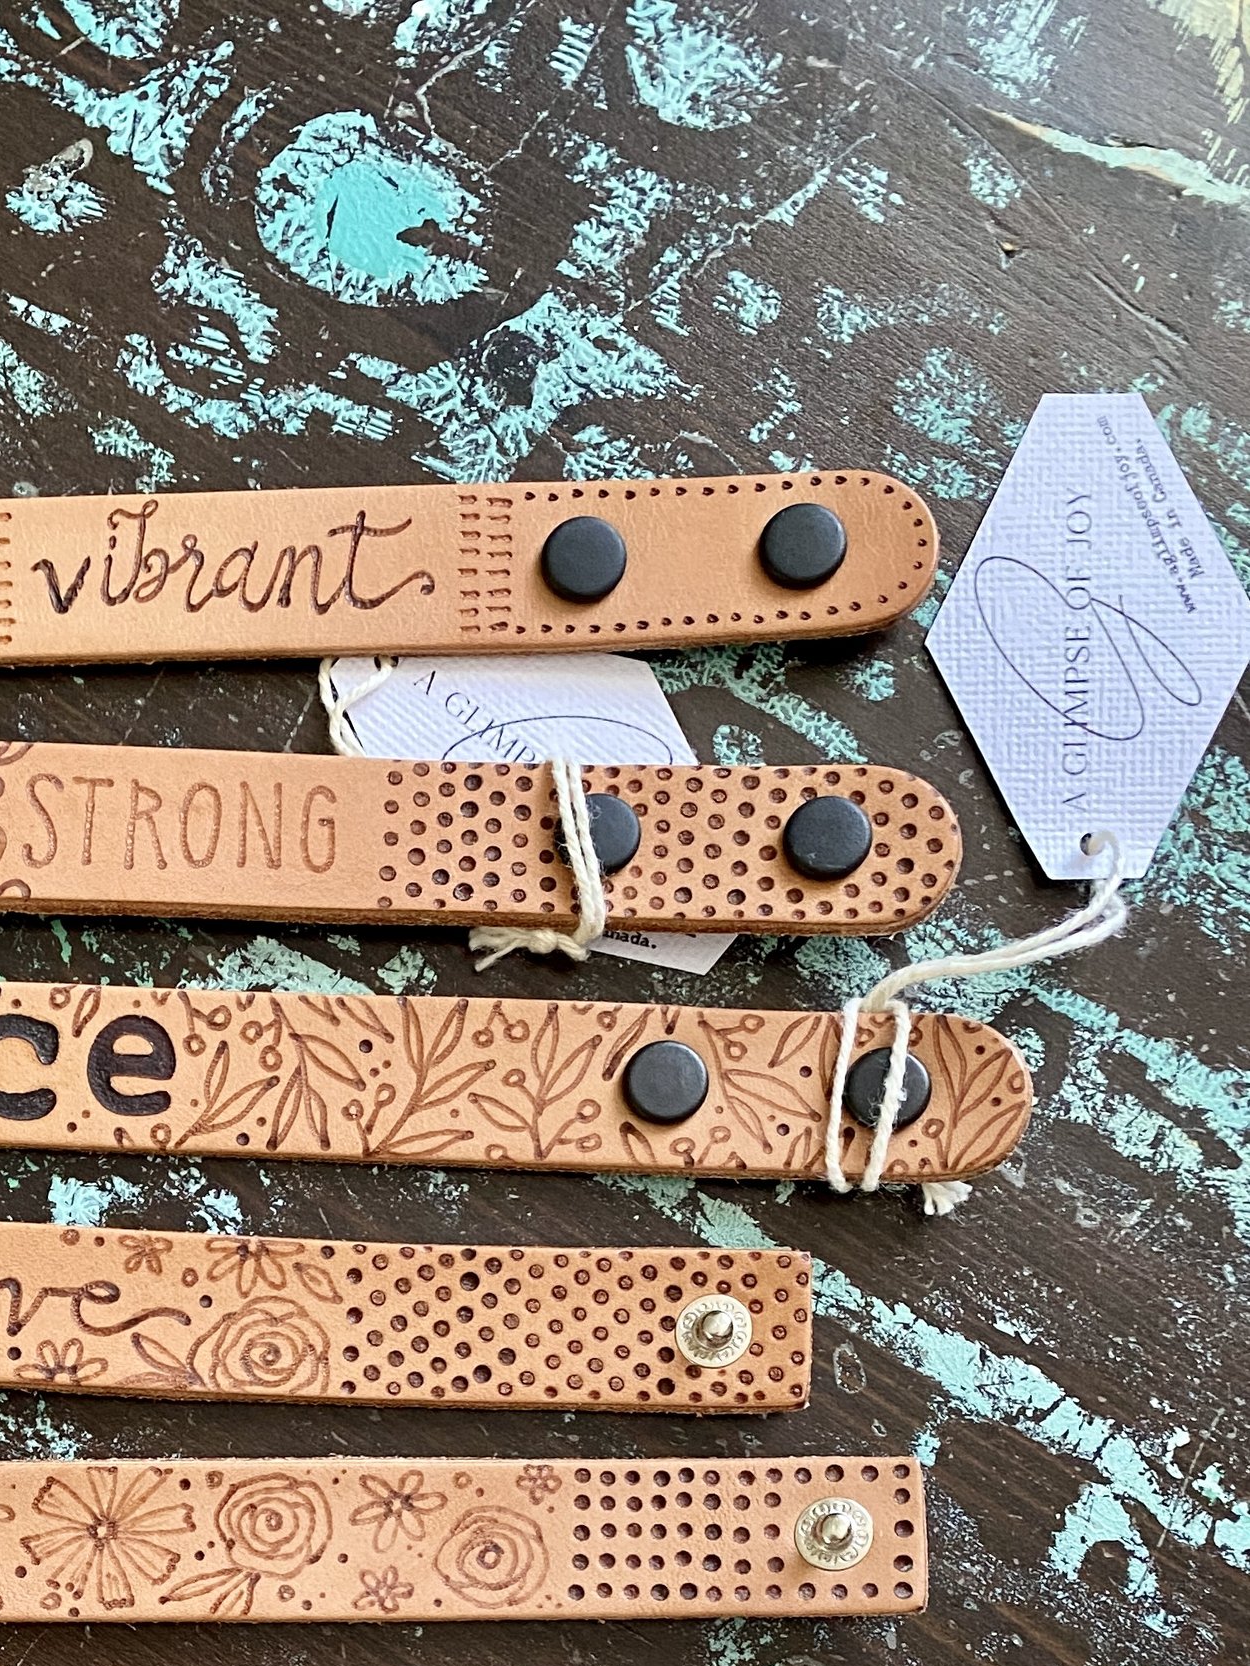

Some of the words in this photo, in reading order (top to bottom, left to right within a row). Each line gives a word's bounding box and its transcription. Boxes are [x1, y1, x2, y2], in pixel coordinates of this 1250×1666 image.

[1067, 488, 1093, 549] JOY
[1166, 508, 1183, 529] in
[30, 499, 436, 615] vibrant
[1180, 537, 1205, 580] Made
[1065, 566, 1092, 610] OF
[413, 670, 437, 696] A
[1062, 626, 1091, 775] GLIMPSE
[22, 773, 338, 874] STRONG
[1062, 793, 1087, 813] A
